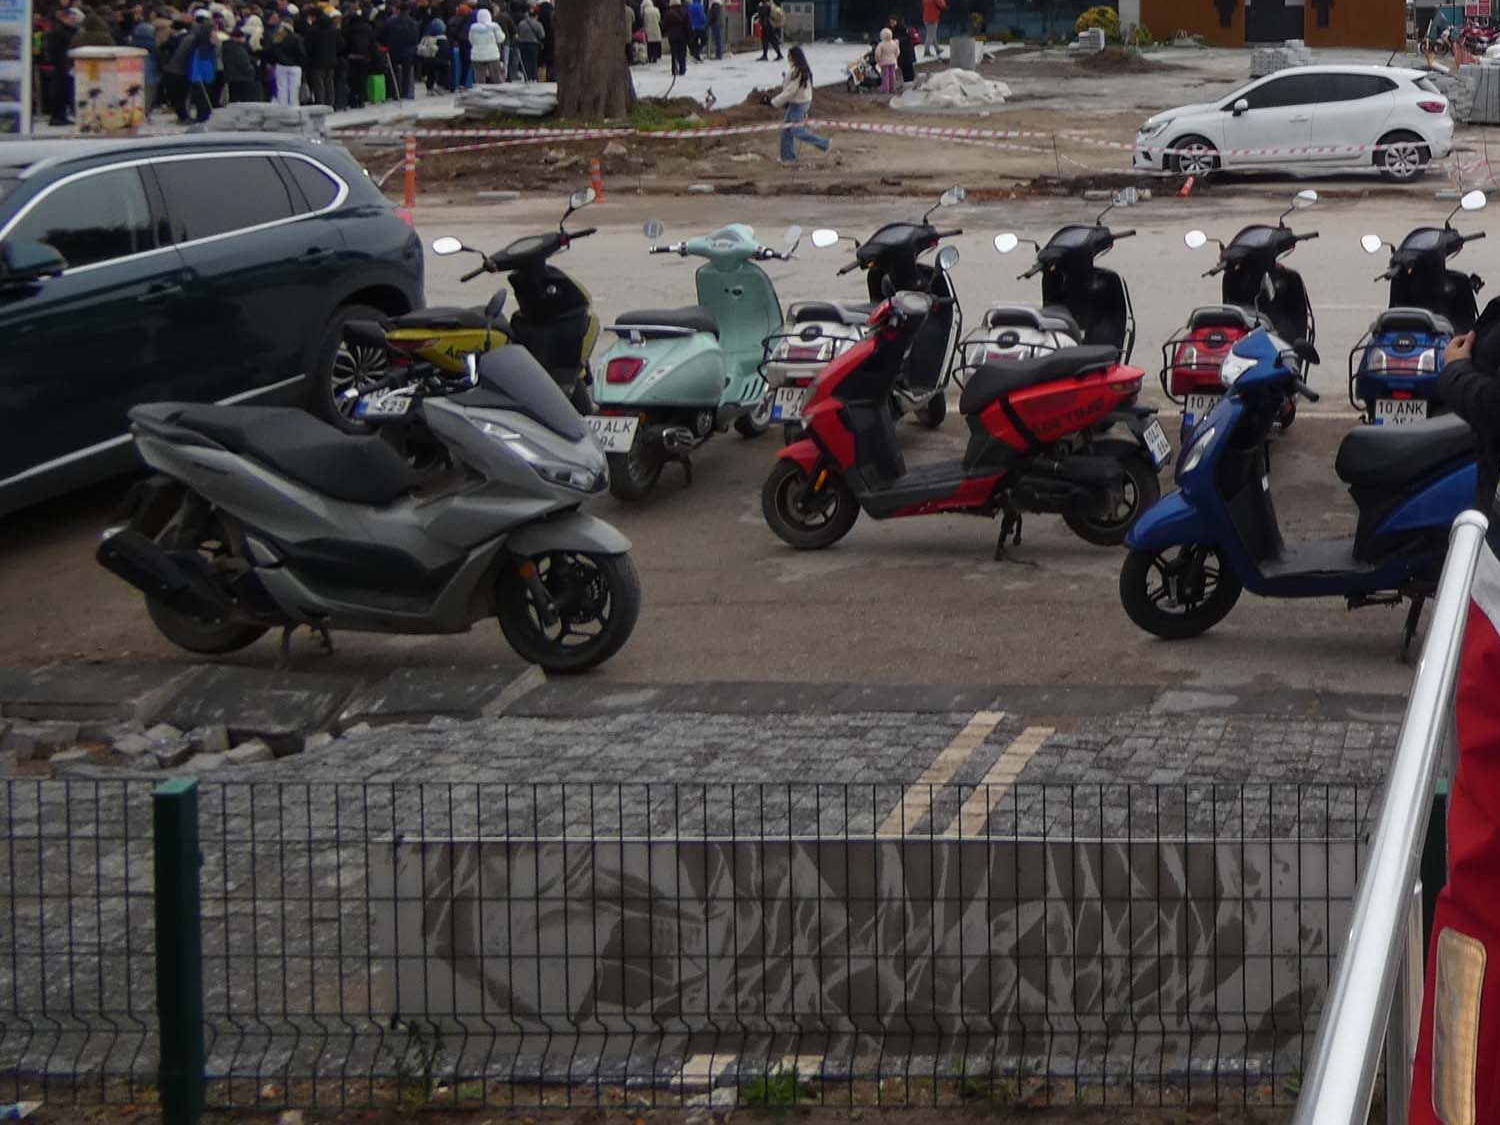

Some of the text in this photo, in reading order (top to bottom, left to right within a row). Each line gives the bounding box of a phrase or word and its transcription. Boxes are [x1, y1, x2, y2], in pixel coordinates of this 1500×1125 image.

[1379, 402, 1424, 416] 10 ANK
[603, 419, 633, 433] ALK
